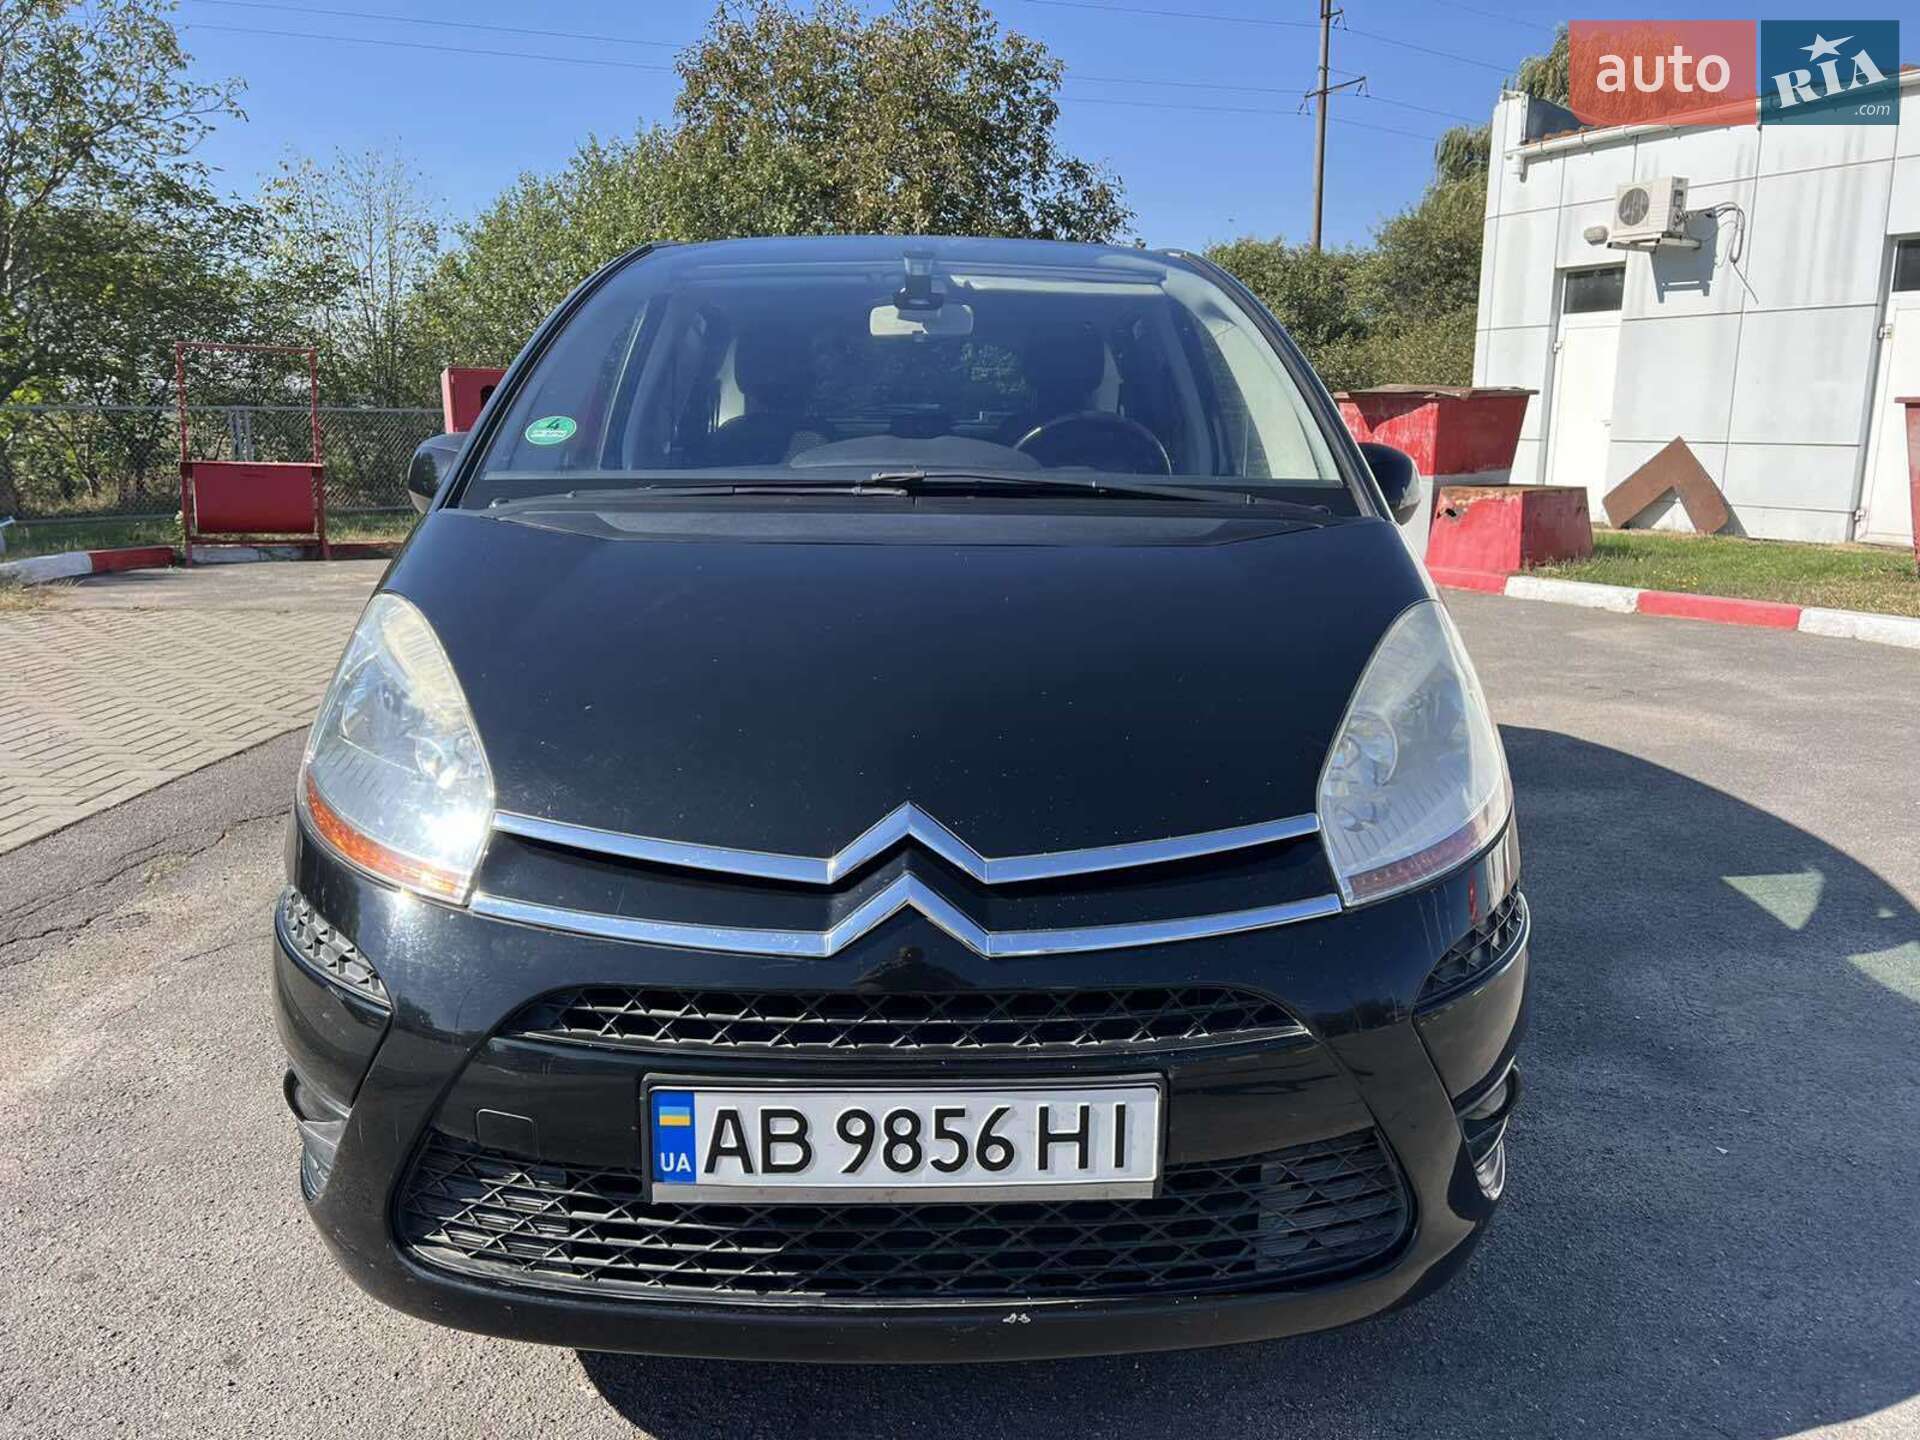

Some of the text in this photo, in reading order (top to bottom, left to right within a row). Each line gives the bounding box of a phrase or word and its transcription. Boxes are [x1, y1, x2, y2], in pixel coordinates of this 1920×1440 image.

[703, 1103, 1126, 1174] AB 9856 HI
[660, 1152, 691, 1173] UA
